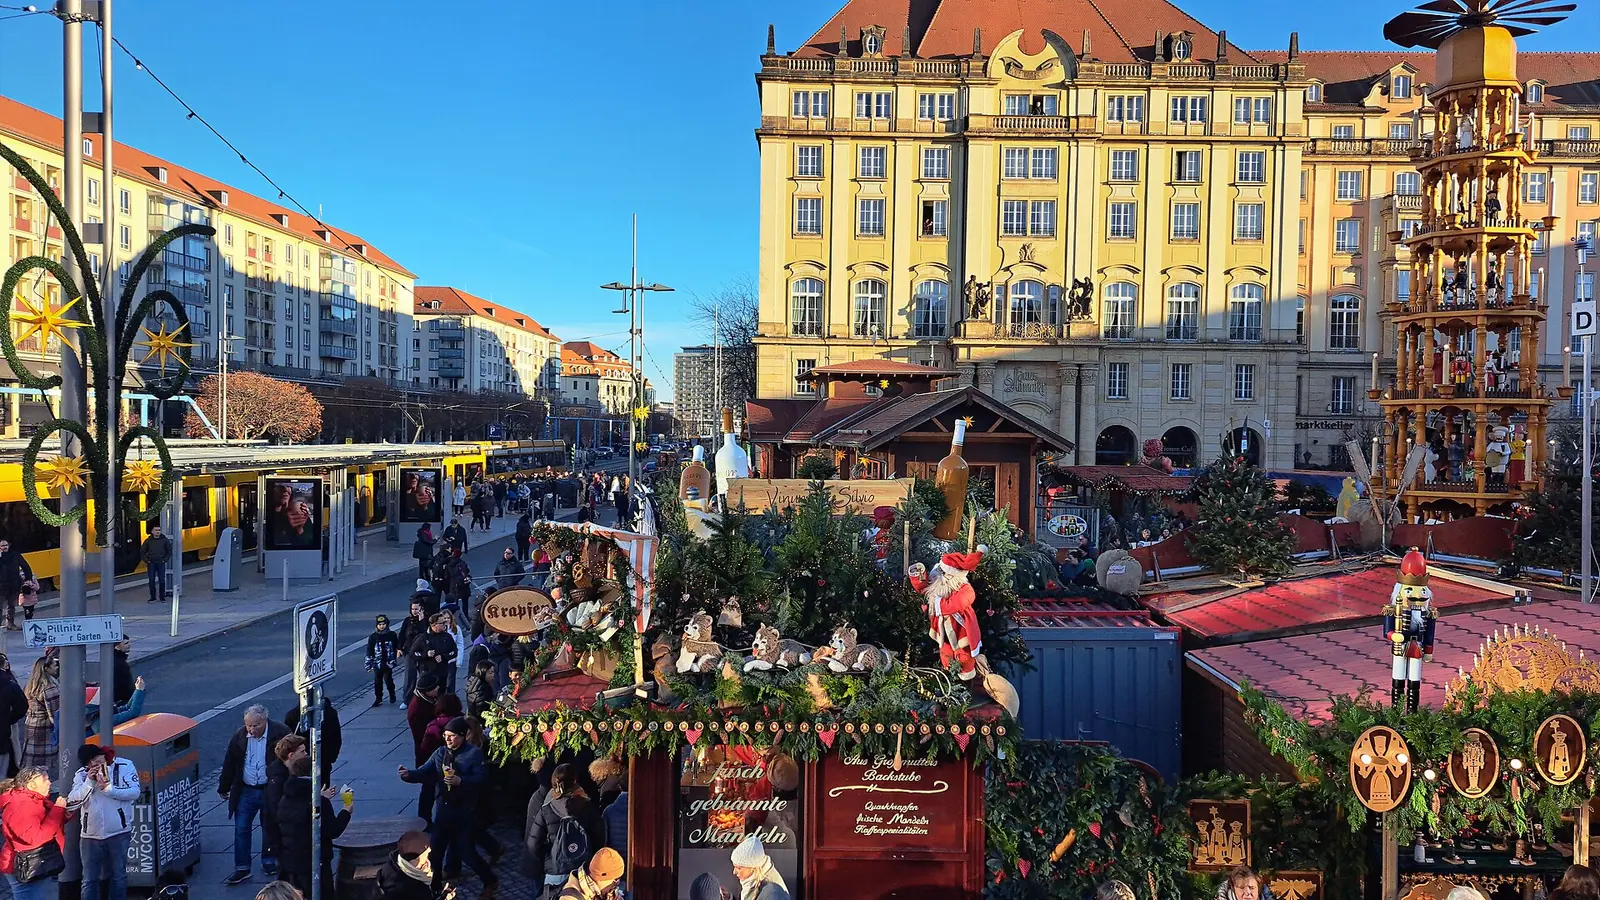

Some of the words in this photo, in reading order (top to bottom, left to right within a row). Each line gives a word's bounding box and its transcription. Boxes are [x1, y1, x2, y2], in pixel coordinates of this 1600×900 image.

[1576, 311, 1592, 330] D
[833, 486, 875, 508] Silvio
[47, 624, 82, 633] Pillnitz
[104, 621, 112, 630] 11
[76, 633, 101, 642] Garten
[308, 659, 326, 677] ZONE
[843, 754, 867, 766] Aus
[872, 754, 938, 769] Gromutters
[703, 759, 766, 784] frisch
[862, 769, 922, 782] Backstube
[157, 776, 191, 805] BASURA
[686, 793, 788, 816] gebrannte
[864, 801, 919, 813] Quarkkrapfen
[184, 798, 194, 855] TRASH
[855, 813, 883, 825] frische
[887, 813, 929, 825] Mandeln
